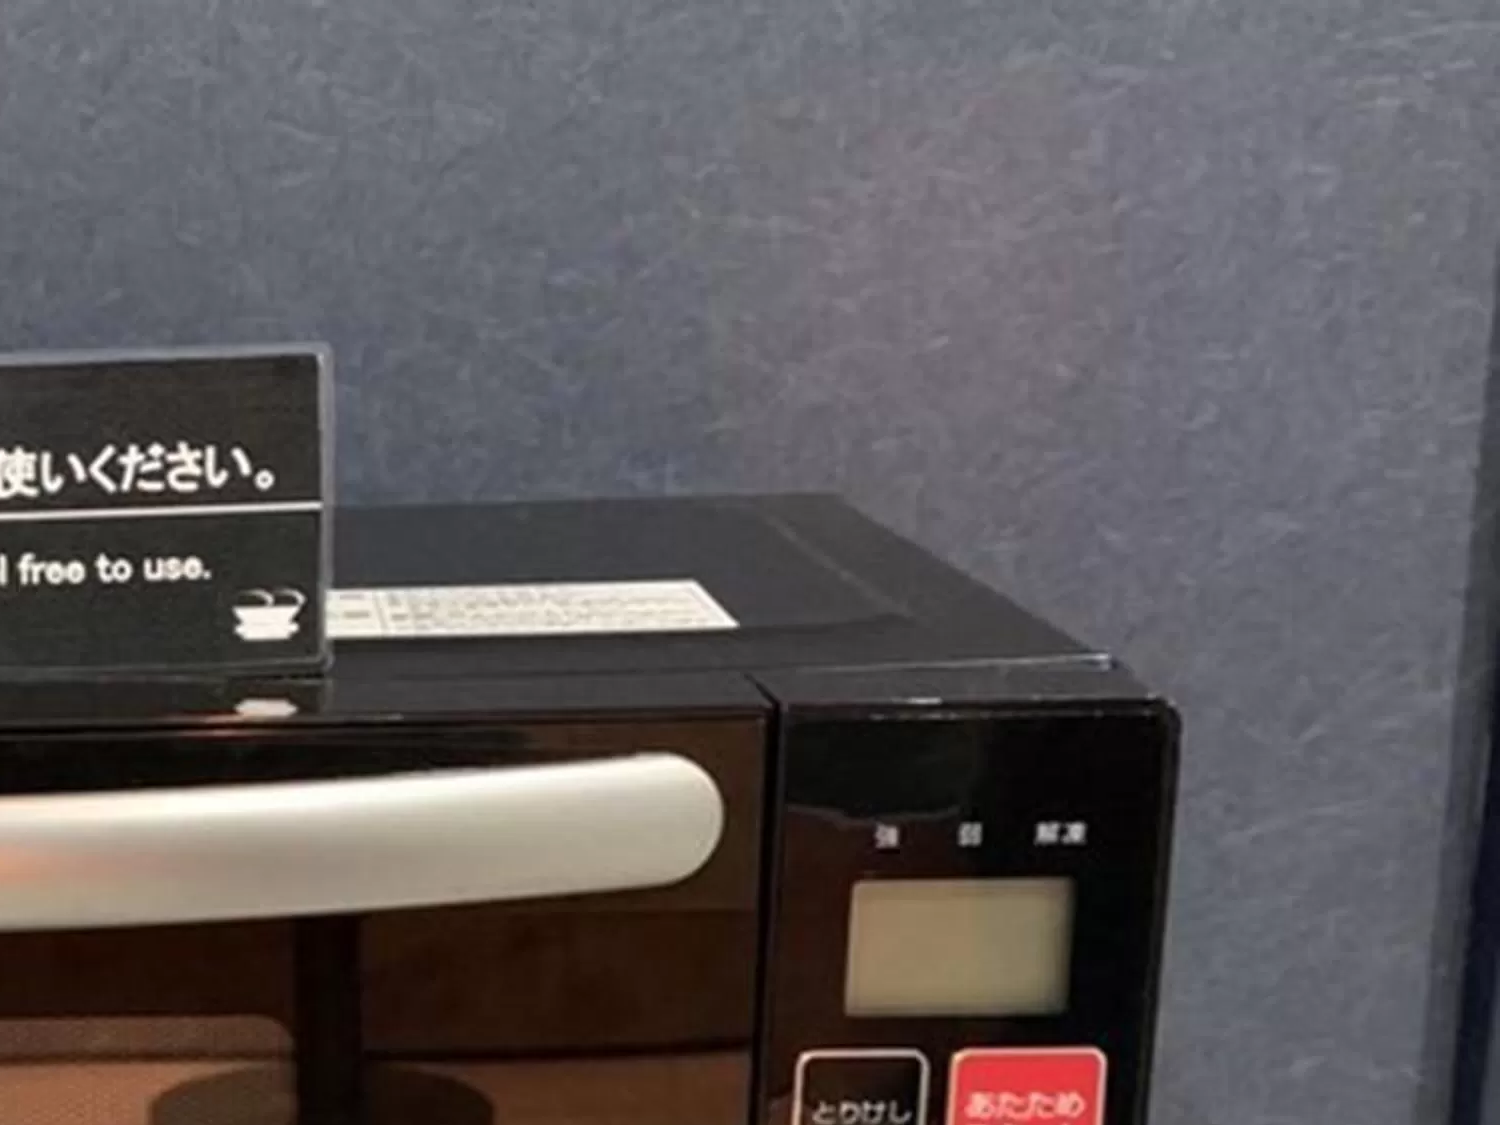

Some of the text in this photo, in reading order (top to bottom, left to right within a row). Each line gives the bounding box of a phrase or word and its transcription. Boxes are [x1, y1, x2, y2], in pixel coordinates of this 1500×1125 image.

[18, 553, 85, 585] free
[96, 555, 133, 583] to
[143, 555, 211, 582] use.
[964, 1091, 1086, 1120] あたため
